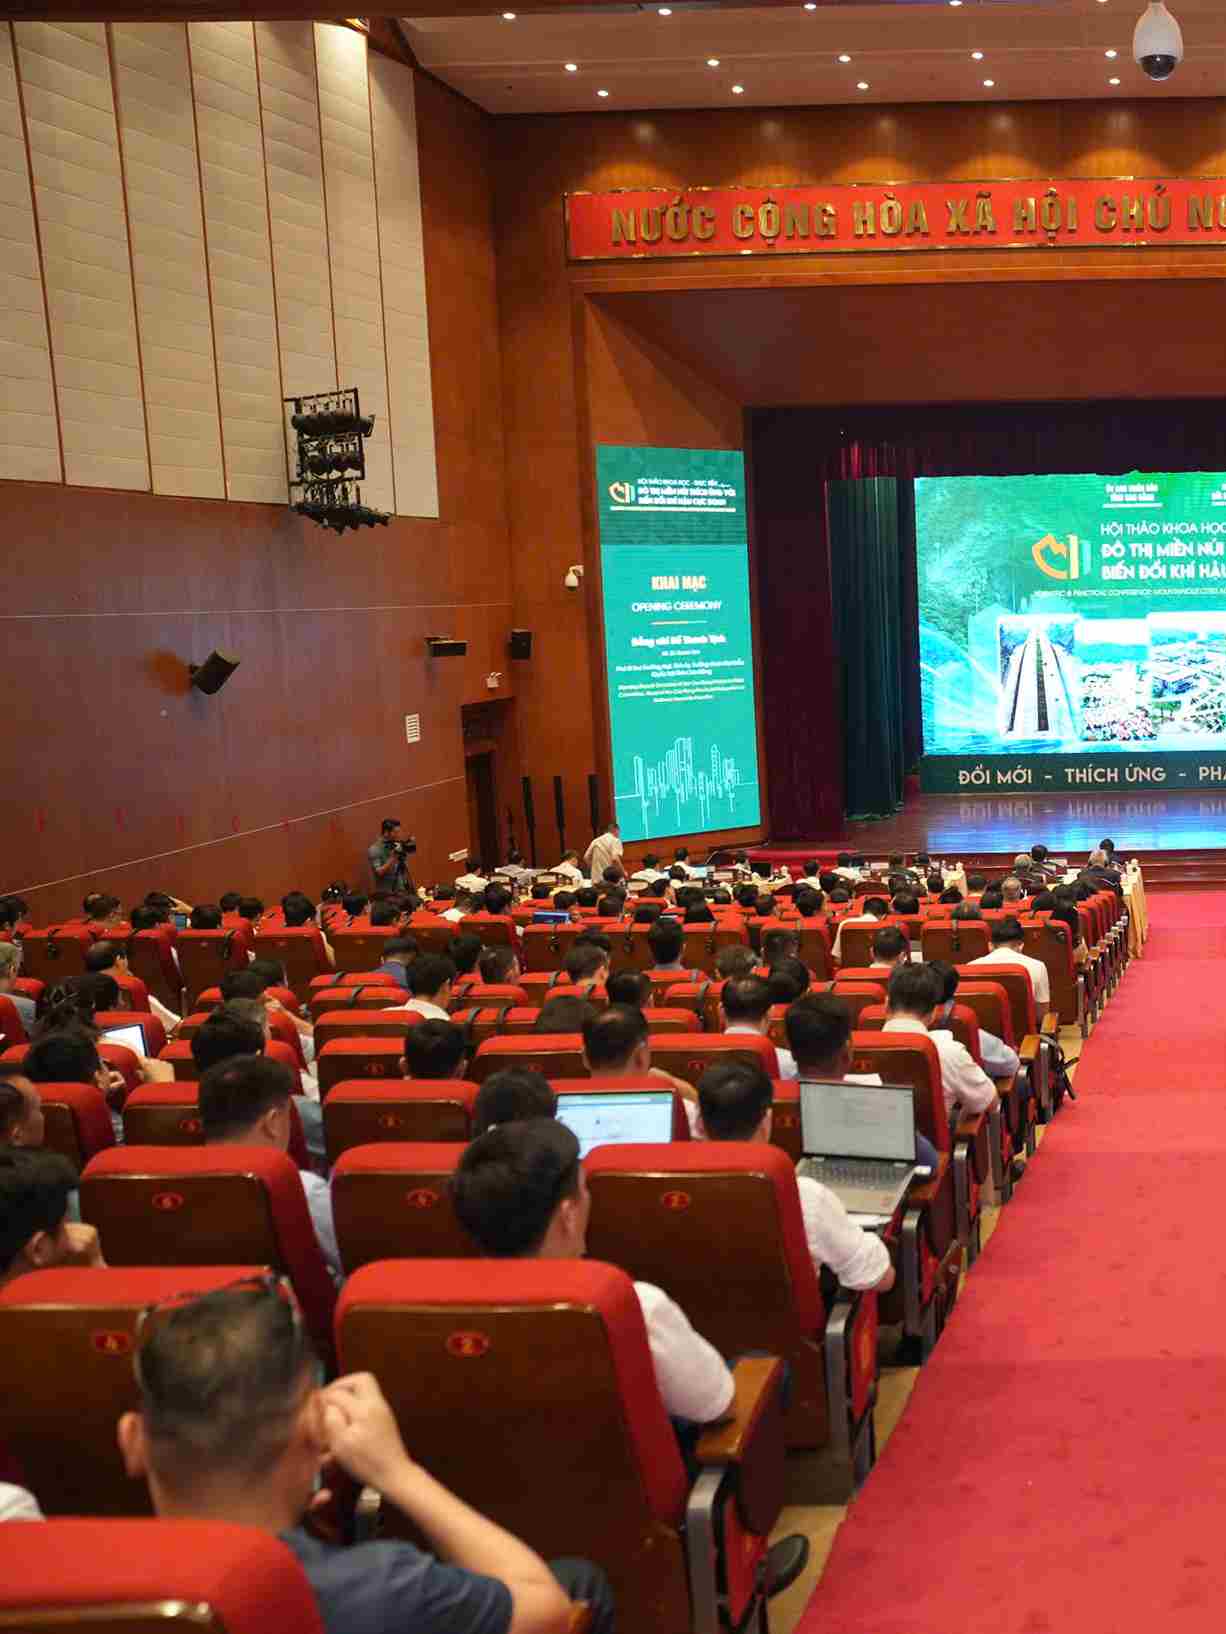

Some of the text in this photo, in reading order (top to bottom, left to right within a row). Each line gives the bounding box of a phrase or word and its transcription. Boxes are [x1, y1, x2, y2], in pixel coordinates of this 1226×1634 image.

[611, 196, 717, 245] NƯỚC
[732, 197, 838, 247] CỘNG
[854, 192, 930, 238] HÒA
[944, 191, 997, 234] XÃ
[1012, 187, 1077, 247] HỘI
[1093, 184, 1172, 233] CHỦ
[1100, 522, 1123, 537] HỘI
[1126, 521, 1160, 535] THẢO
[1163, 522, 1197, 534] KHOA
[1101, 540, 1126, 557] ĐÔ
[1156, 538, 1195, 557] MIỀN
[1197, 538, 1224, 556] NÚI
[1170, 561, 1195, 578] KHÍ
[958, 764, 990, 785] ĐỔI
[997, 764, 1033, 784] MỚI
[1064, 763, 1119, 783] THÍCH
[1125, 762, 1166, 782] ỨNG
